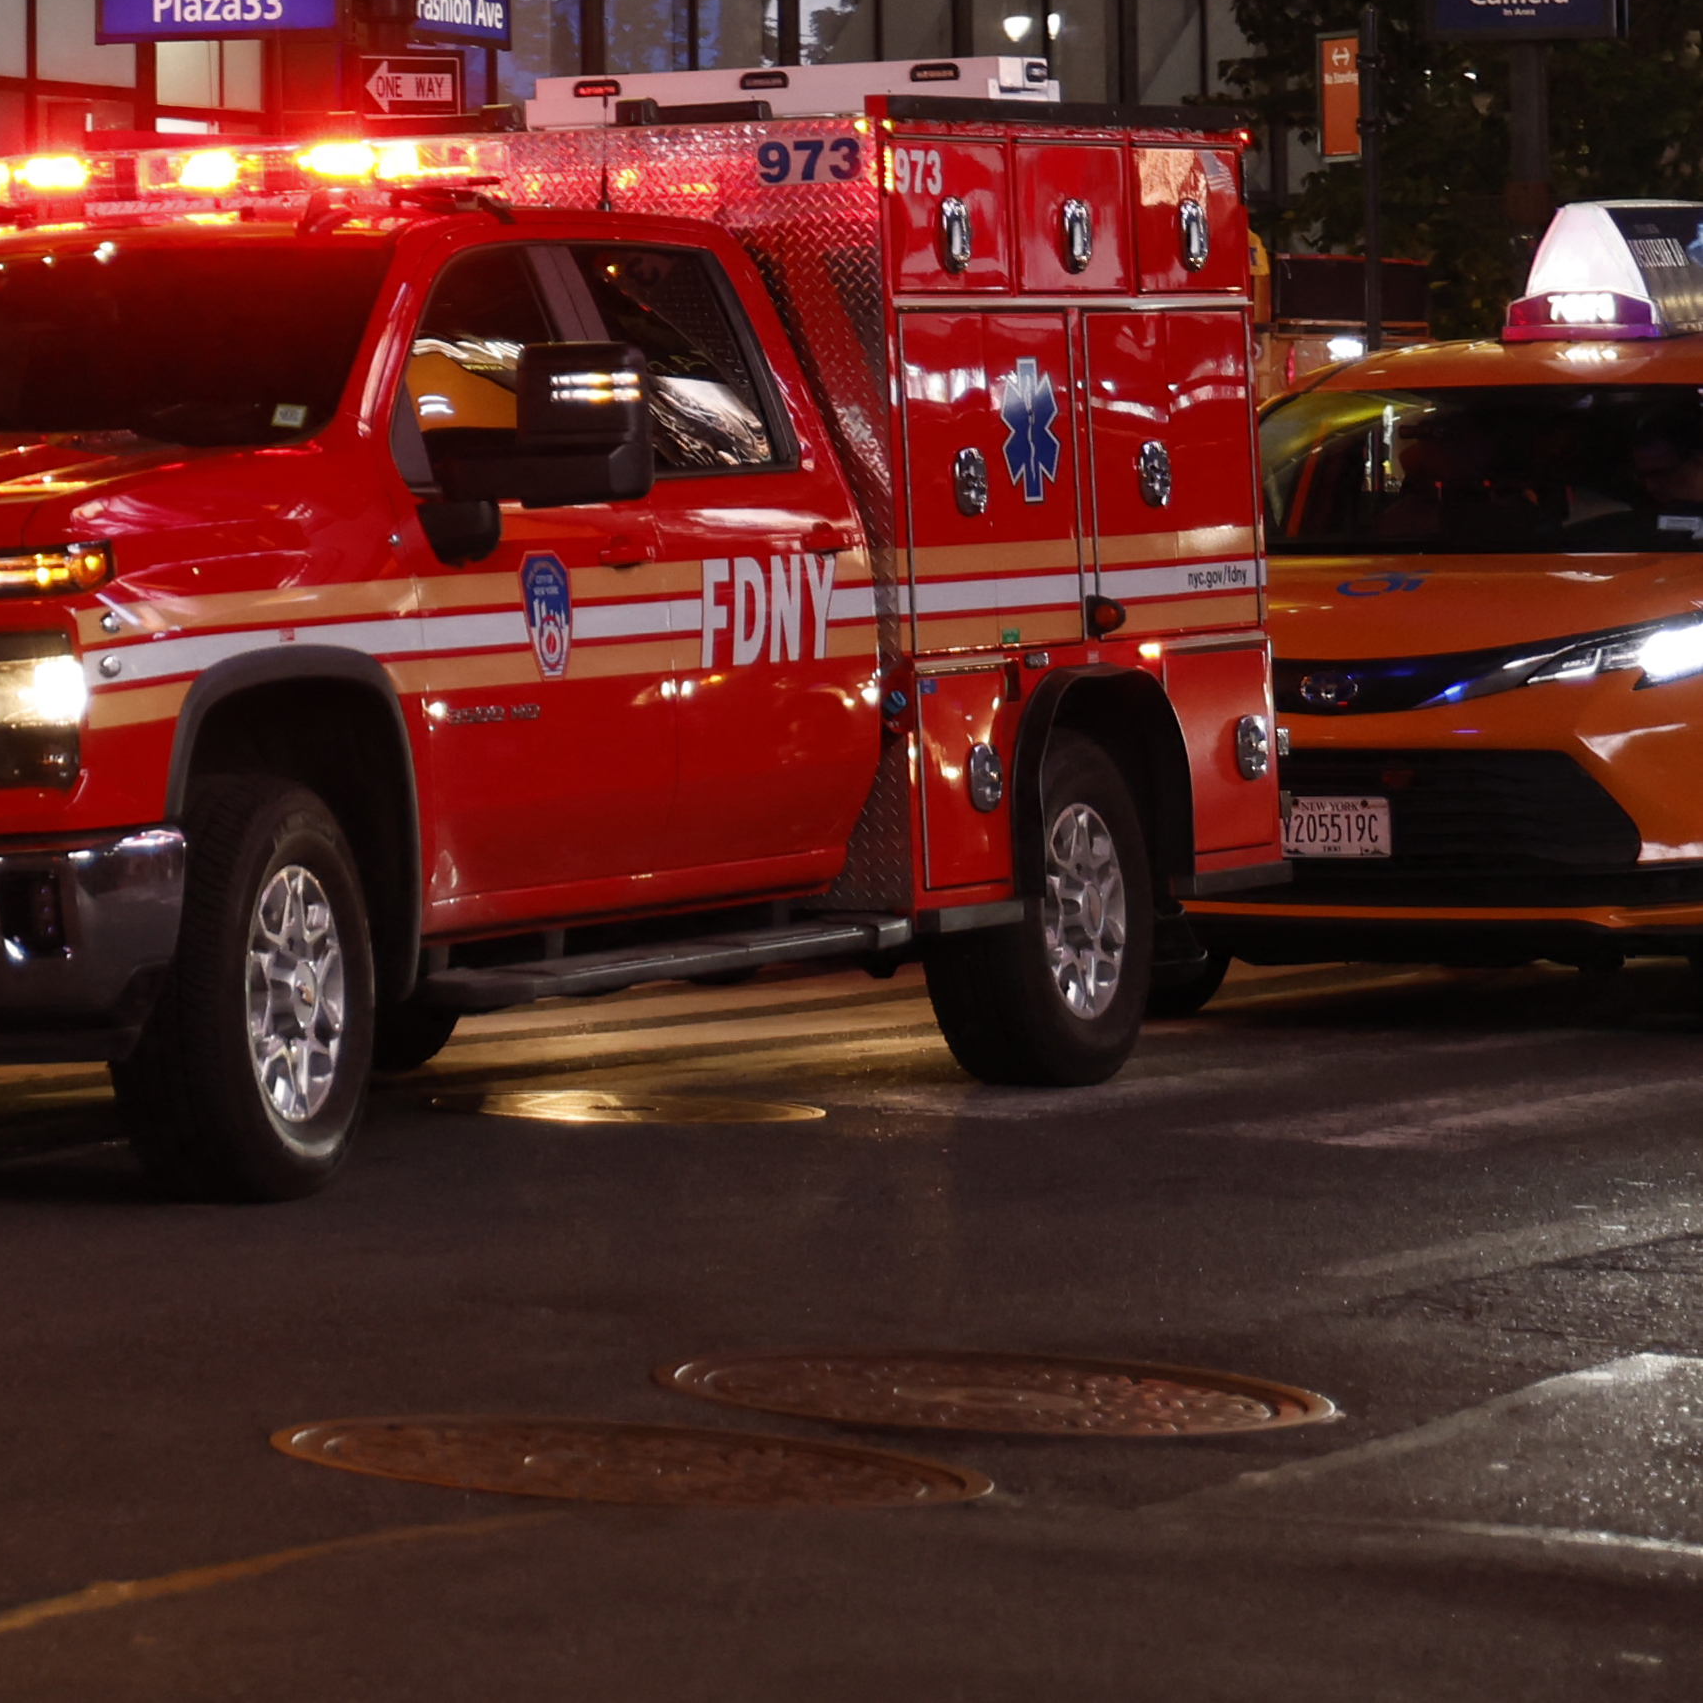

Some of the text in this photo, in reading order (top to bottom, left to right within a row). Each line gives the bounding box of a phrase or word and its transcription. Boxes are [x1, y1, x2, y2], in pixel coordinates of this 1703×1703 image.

[375, 75, 445, 100] ONE WAY
[757, 137, 862, 183] 973
[893, 148, 943, 196] 973
[1188, 565, 1247, 589] nyc.gov/fdny
[700, 551, 837, 670] FDNY
[1301, 801, 1360, 812] NEW YORK
